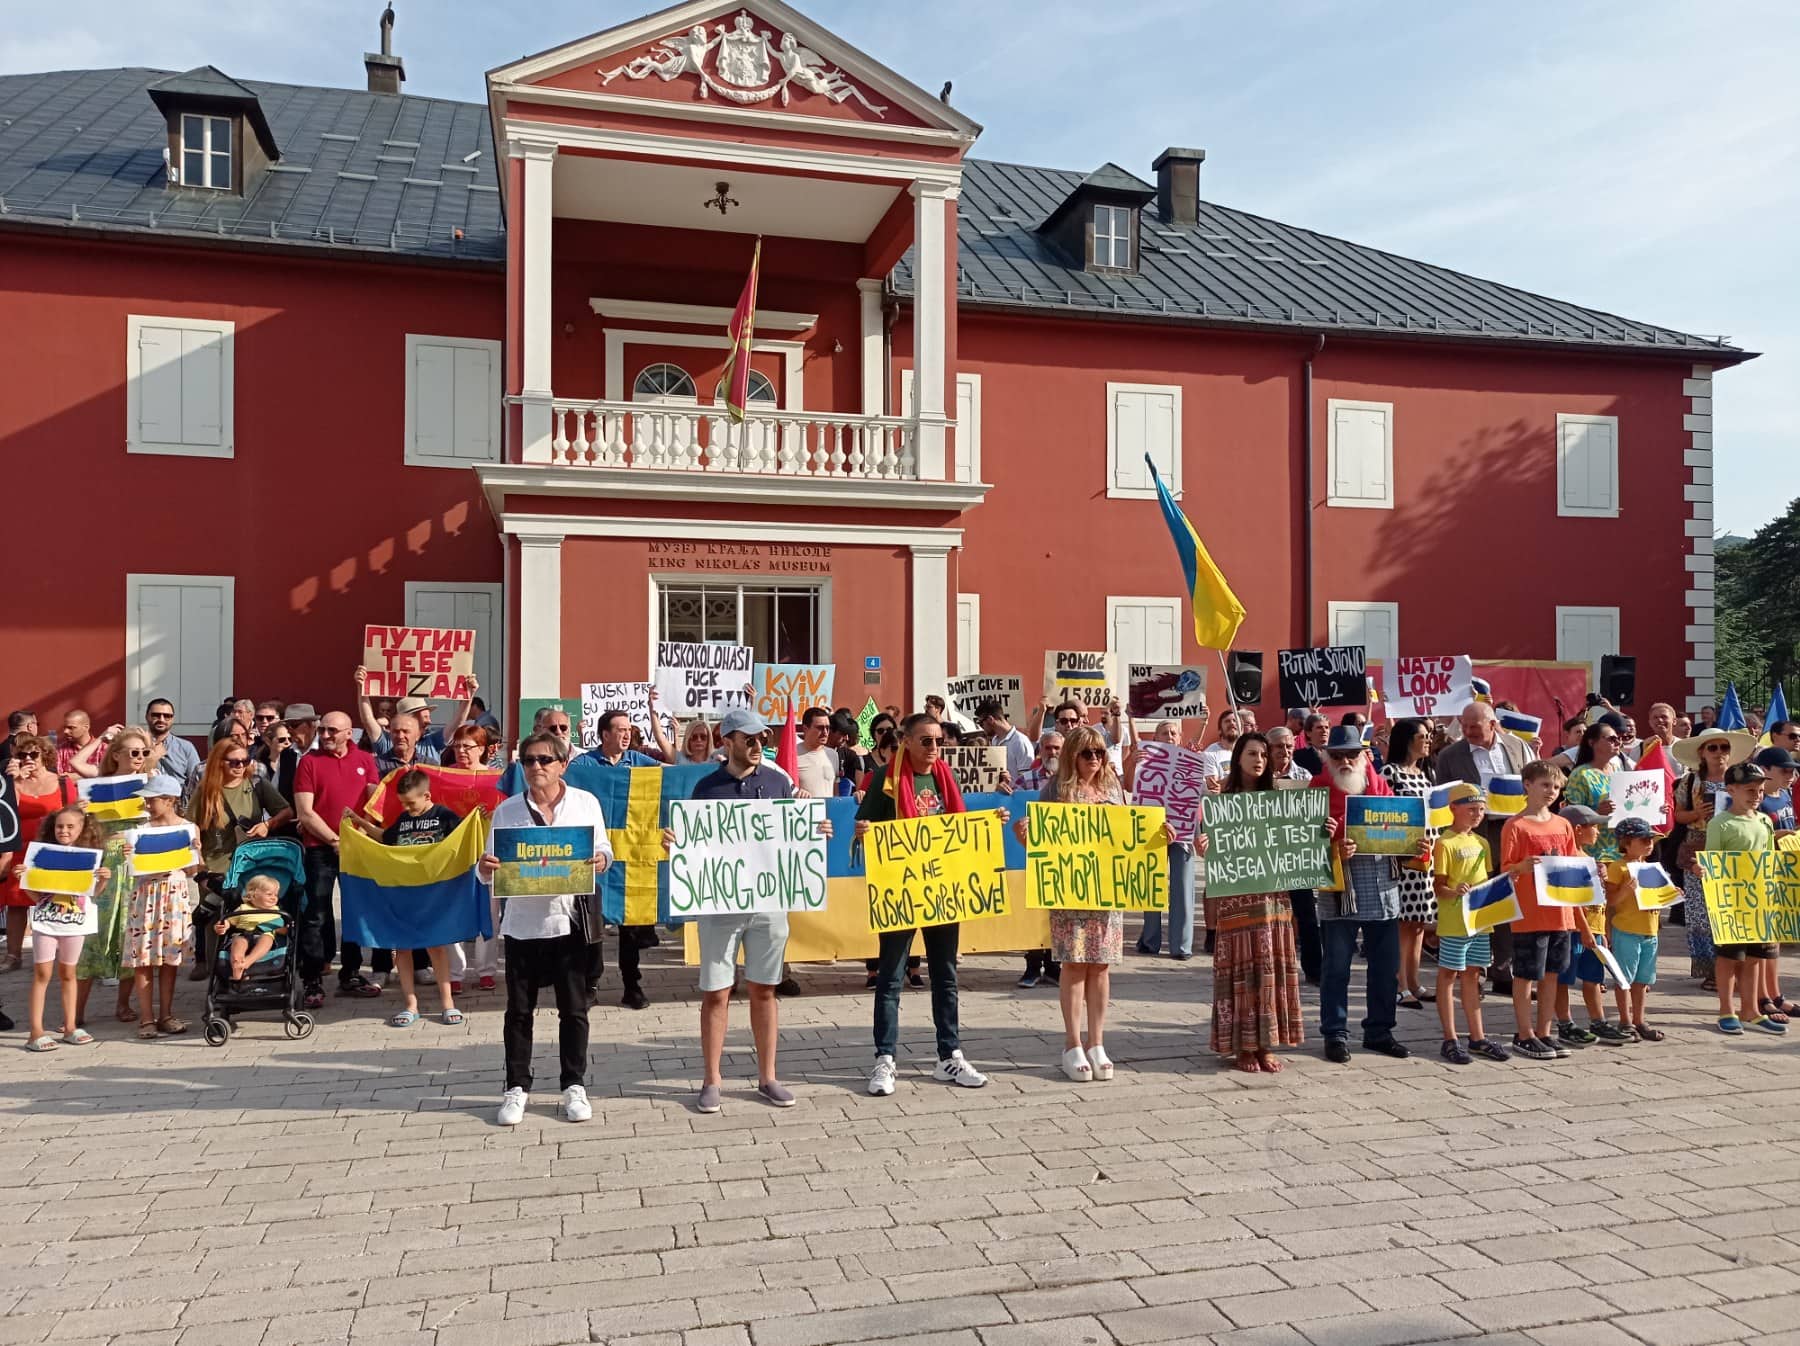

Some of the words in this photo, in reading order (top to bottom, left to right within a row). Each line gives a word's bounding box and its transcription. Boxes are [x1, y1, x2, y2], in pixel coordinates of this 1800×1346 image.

[648, 543, 697, 553] МУЗЕЈ
[707, 543, 760, 556] КРАЉА
[769, 545, 831, 558] НИКОЛЕ
[648, 557, 686, 568] KING
[769, 560, 831, 572] MUSEUM
[366, 626, 472, 652] ПУТИН
[382, 649, 454, 673] ТЕБЕ
[870, 659, 876, 667] 4
[1056, 652, 1105, 670] POMOĆ
[1324, 647, 1365, 677] SOTONO
[1397, 656, 1455, 675] NATO
[686, 670, 719, 687] FUCK
[1131, 666, 1153, 678] NOT
[947, 680, 975, 695] DONT
[978, 678, 1003, 691] GIVE
[1008, 678, 1020, 691] IN
[1397, 672, 1452, 697] LOOK
[1059, 687, 1111, 706] 15888
[1413, 696, 1438, 715] UP
[583, 702, 598, 715] SU
[604, 699, 650, 712] DUBOK
[1164, 702, 1203, 717] TODAY!
[1201, 794, 1243, 827] ODNOS
[1364, 808, 1409, 824] Цетиње
[717, 802, 751, 844] RAT
[751, 813, 775, 842] SE
[1281, 824, 1321, 845] TEST
[516, 842, 573, 859] Цетиње
[1208, 854, 1266, 884] NAŠEGA
[1266, 844, 1332, 874] VREMENA
[1698, 852, 1742, 881] NEXT
[1747, 851, 1799, 880] YEAR
[671, 854, 754, 911] SVAKOG
[757, 872, 777, 898] OD
[778, 848, 825, 910] NAS
[903, 866, 917, 884] A
[1112, 852, 1165, 908] EVROPE
[1715, 880, 1759, 908] LET'S
[1764, 881, 1800, 908] PART
[1720, 909, 1755, 941] FREE
